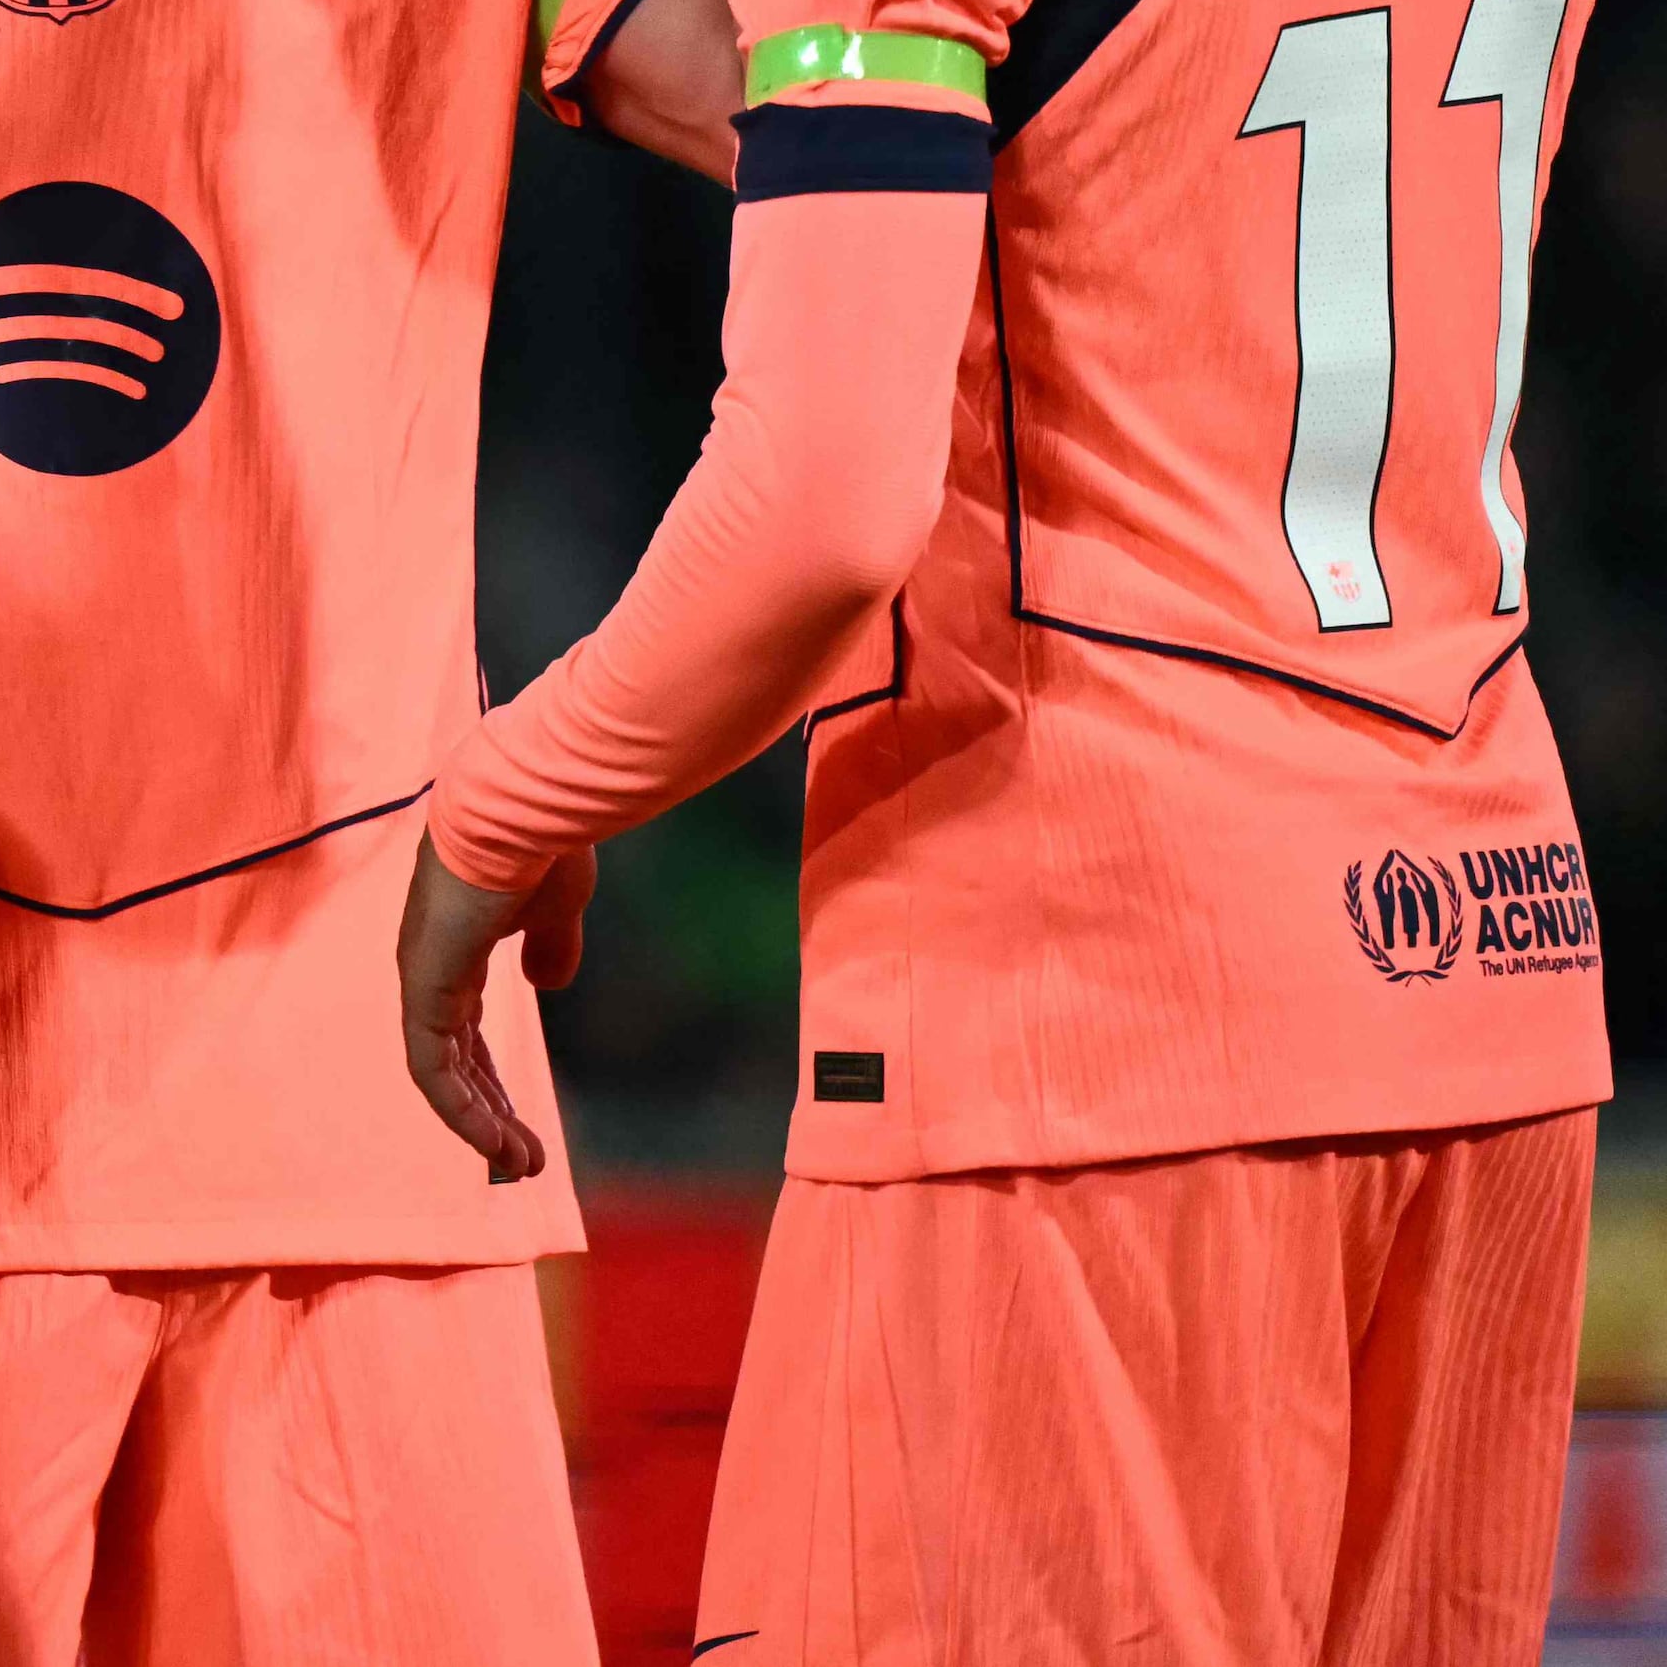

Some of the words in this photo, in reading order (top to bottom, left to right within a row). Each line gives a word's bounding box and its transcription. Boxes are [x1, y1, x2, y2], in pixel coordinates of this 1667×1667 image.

[1459, 842, 1587, 899] UNHCR
[1476, 895, 1596, 954] ACNUR
[1479, 959, 1504, 978] The
[1506, 956, 1526, 976] UN
[1528, 954, 1574, 975] Refugee
